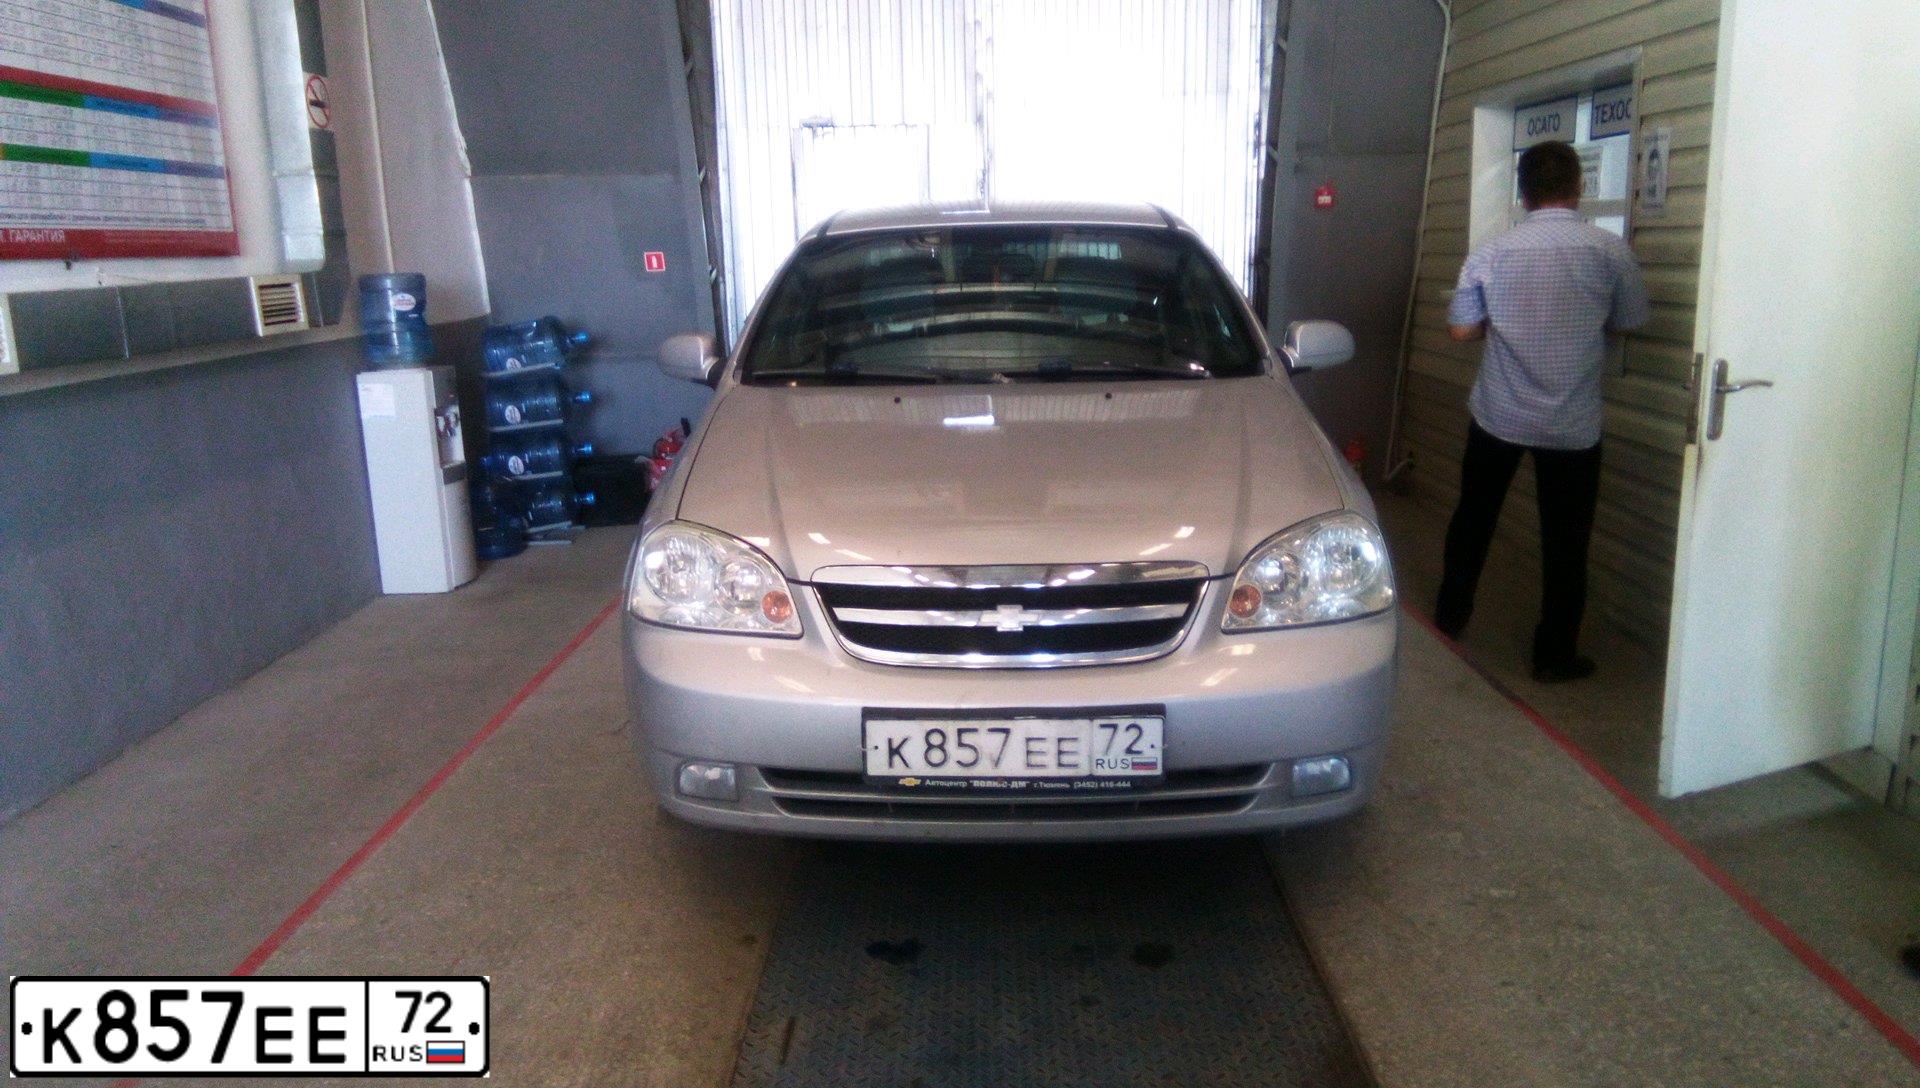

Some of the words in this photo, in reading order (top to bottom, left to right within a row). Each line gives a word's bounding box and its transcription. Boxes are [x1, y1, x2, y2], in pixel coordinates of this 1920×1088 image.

[1526, 111, 1561, 136] ОСАГО
[9, 228, 65, 243] ГАРАНТИЯ
[1098, 723, 1145, 755] 72
[1095, 758, 1130, 769] RUS
[925, 779, 967, 788] Автоцентр
